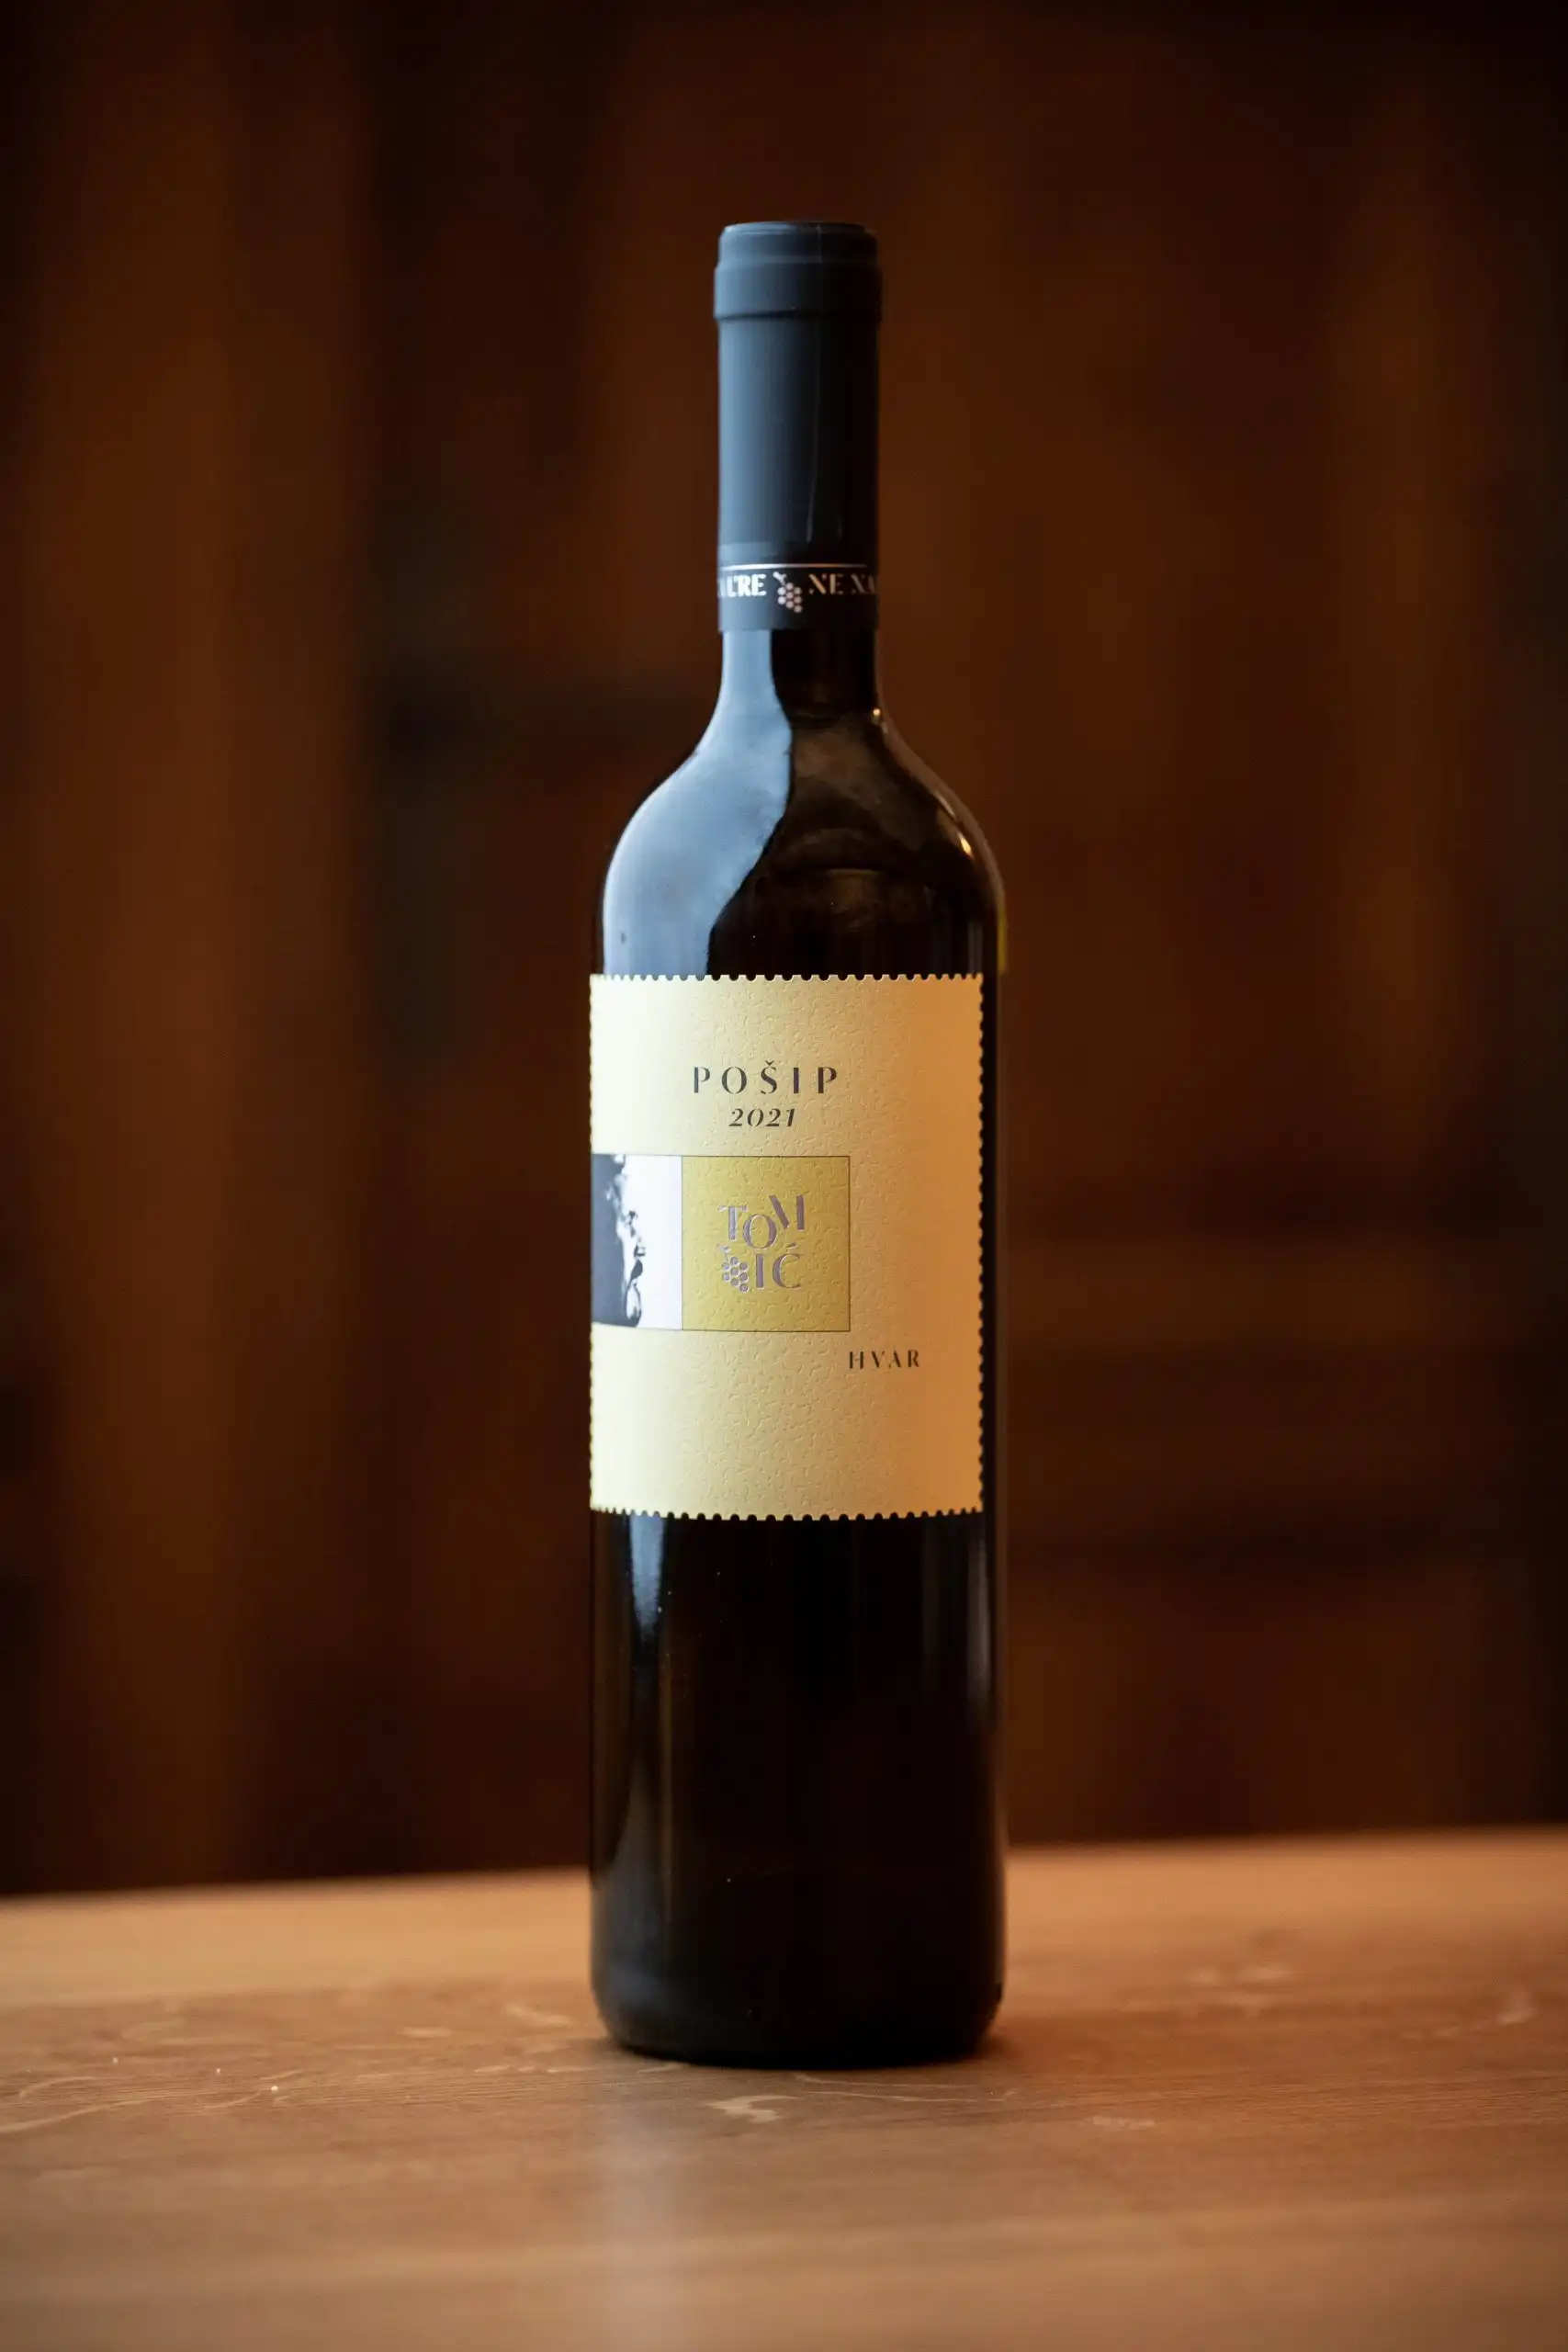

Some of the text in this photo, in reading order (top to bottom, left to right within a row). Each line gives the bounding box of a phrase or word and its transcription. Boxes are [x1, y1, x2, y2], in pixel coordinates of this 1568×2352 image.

[694, 1060, 838, 1094] POŠIP
[728, 1108, 795, 1127] 2021
[717, 1194, 806, 1250] TOM
[849, 1350, 920, 1370] HVAR
